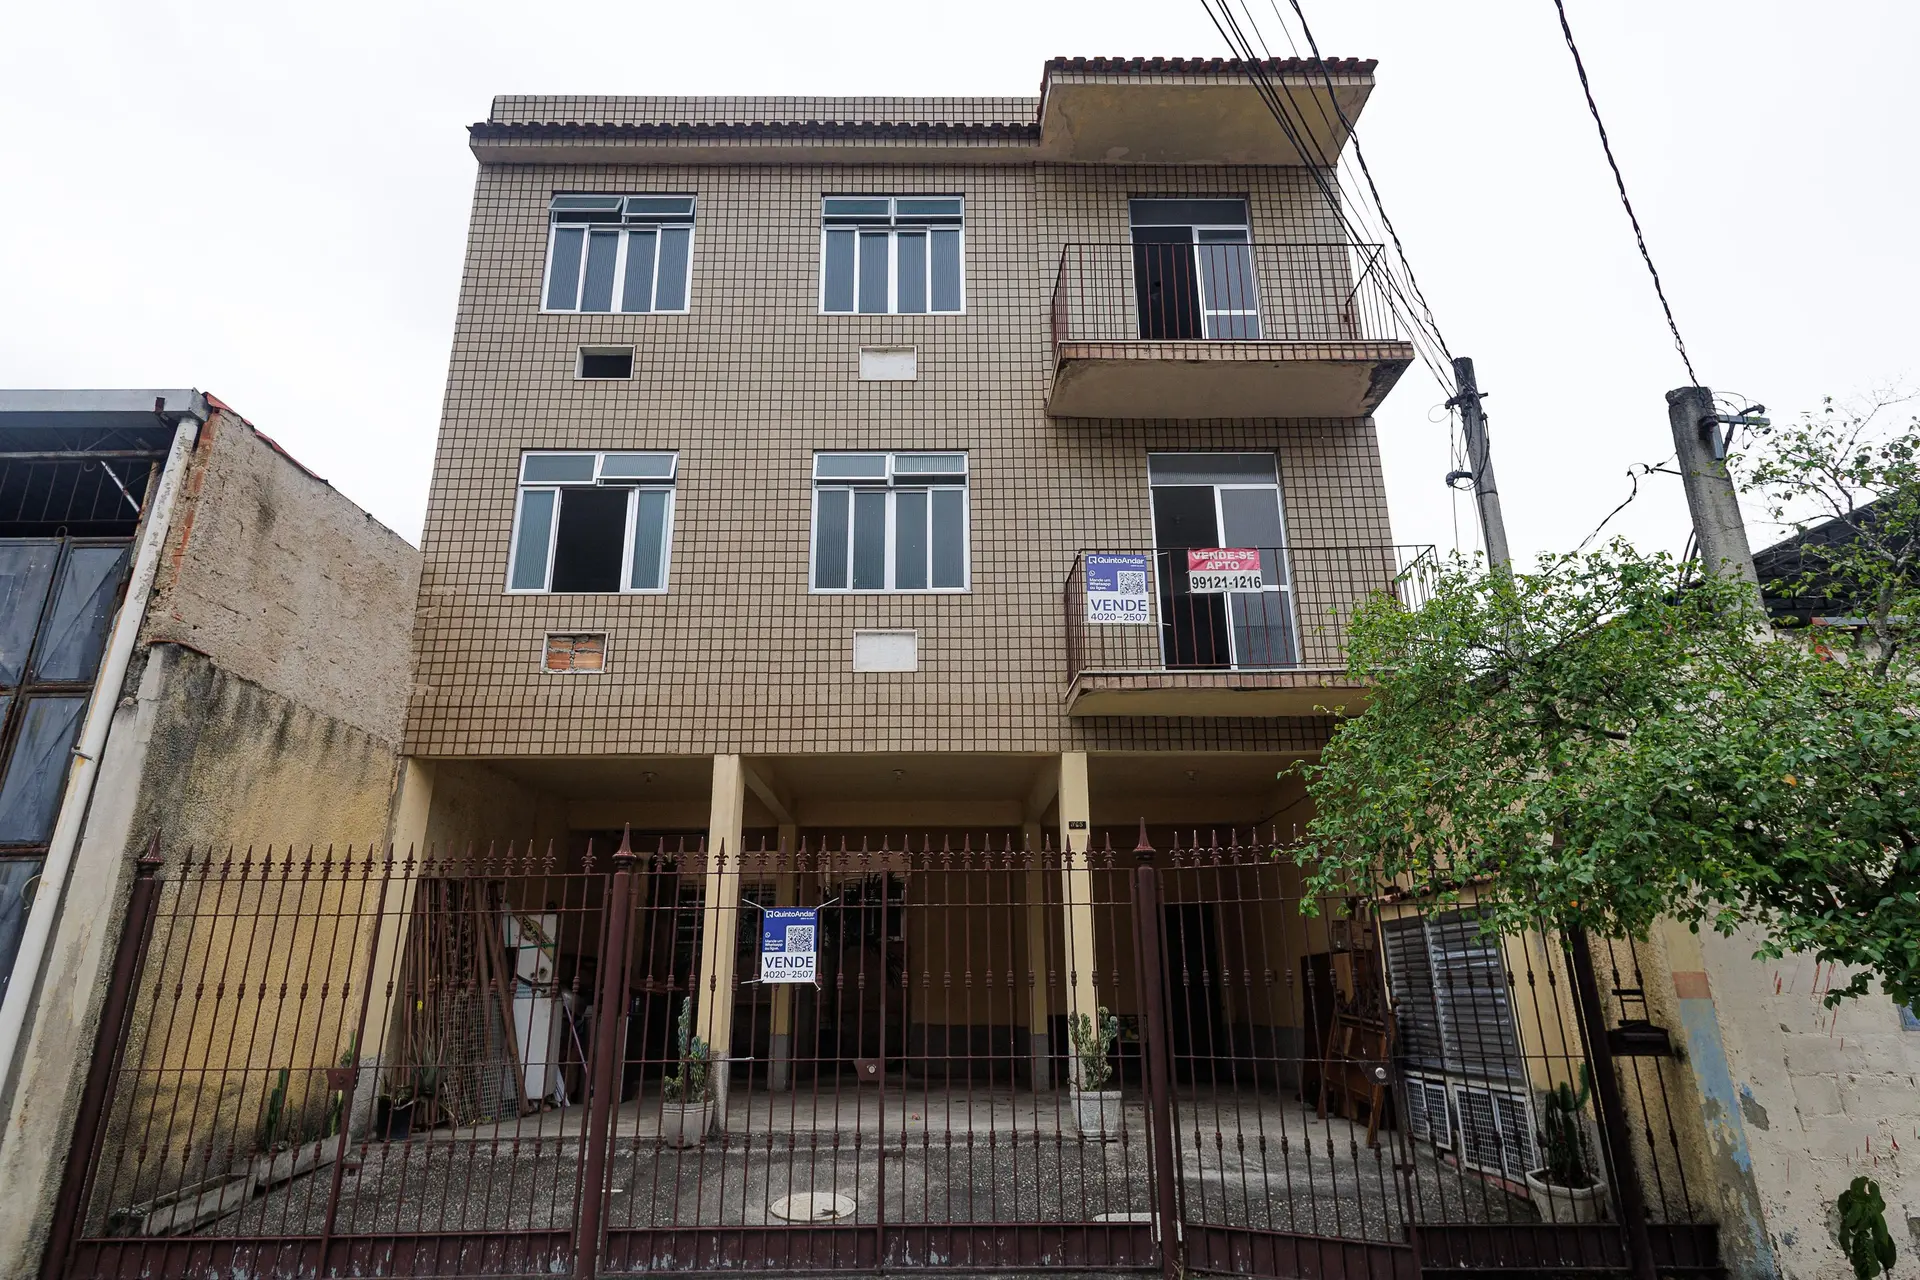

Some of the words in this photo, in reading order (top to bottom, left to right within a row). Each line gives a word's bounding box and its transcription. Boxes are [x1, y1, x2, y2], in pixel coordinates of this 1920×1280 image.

[1192, 551, 1254, 560] VENDE-SE
[1097, 556, 1145, 566] QuintoAndar
[1206, 561, 1240, 570] APTO
[1192, 575, 1261, 589] 99121-1216
[1091, 599, 1147, 612] VENDE
[1091, 612, 1147, 622] 4020-2507
[764, 956, 814, 968] VENDE
[763, 970, 813, 979] 4020-2507
